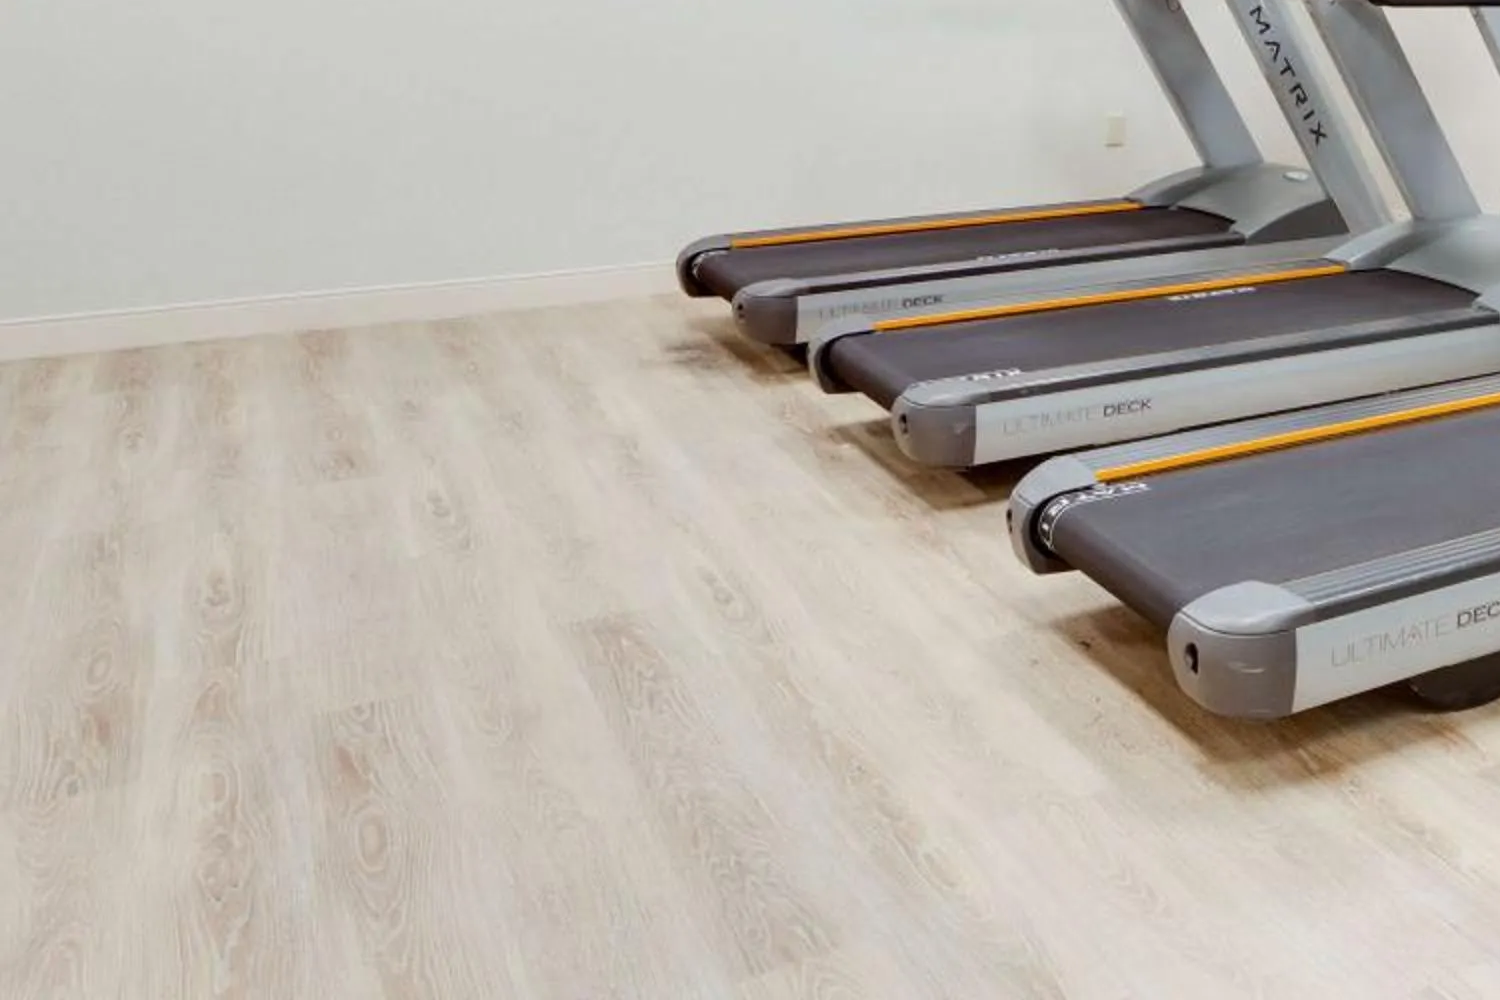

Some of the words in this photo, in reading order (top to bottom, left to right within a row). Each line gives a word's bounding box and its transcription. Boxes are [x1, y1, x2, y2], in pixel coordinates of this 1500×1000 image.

[1249, 4, 1329, 146] MATRIX
[1102, 398, 1153, 418] DECK
[1330, 617, 1450, 667] ULTIMATE
